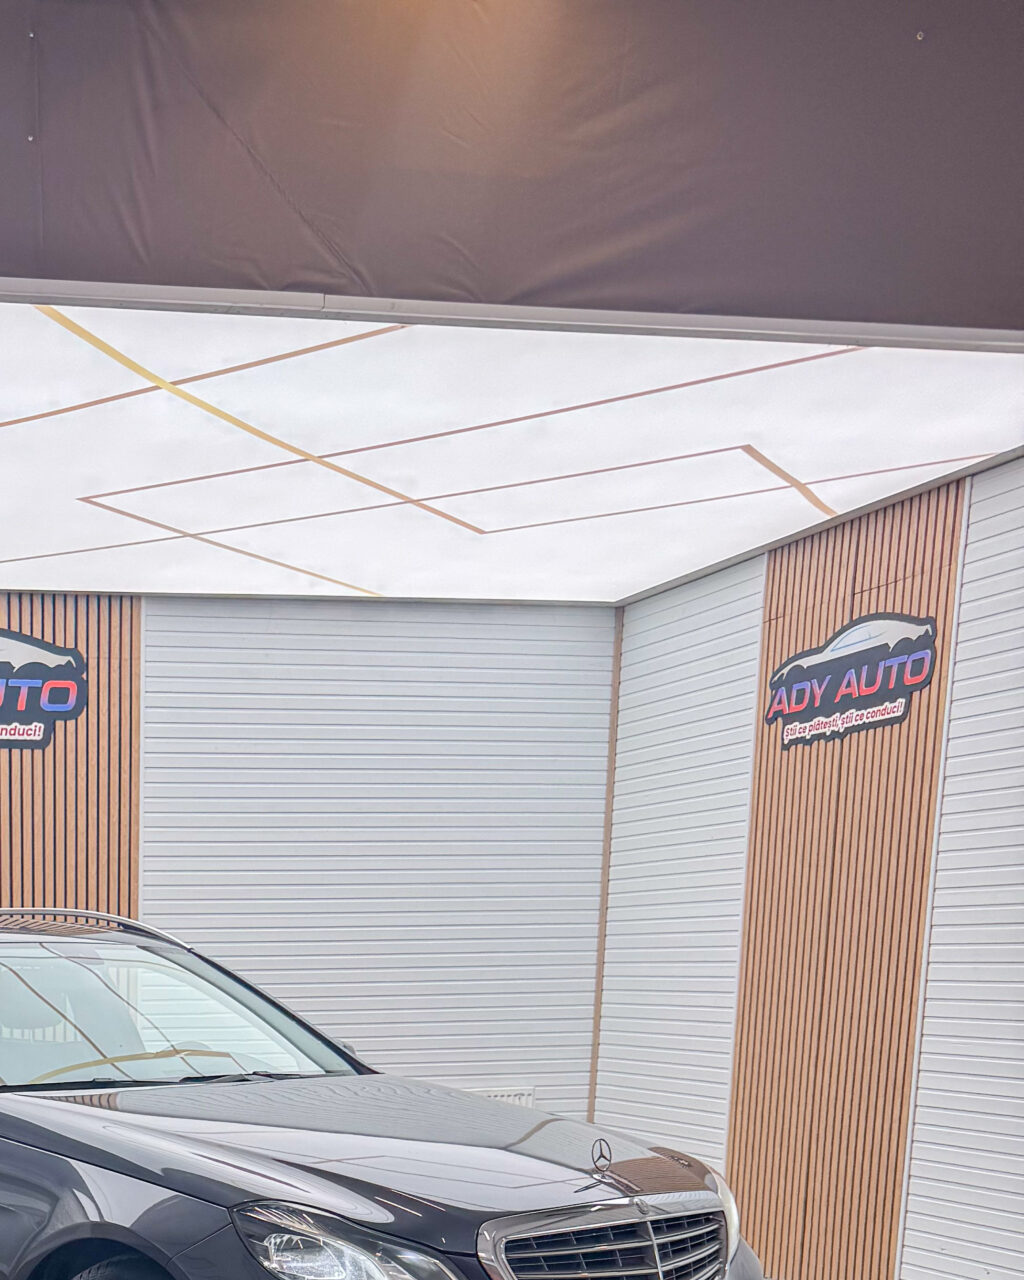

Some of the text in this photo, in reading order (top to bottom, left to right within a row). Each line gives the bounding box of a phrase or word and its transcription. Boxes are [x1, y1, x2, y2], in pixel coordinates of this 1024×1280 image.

[767, 649, 932, 719] ADY AUTO
[798, 725, 807, 735] ce
[854, 712, 864, 722] ce
[865, 701, 903, 720] conduci!
